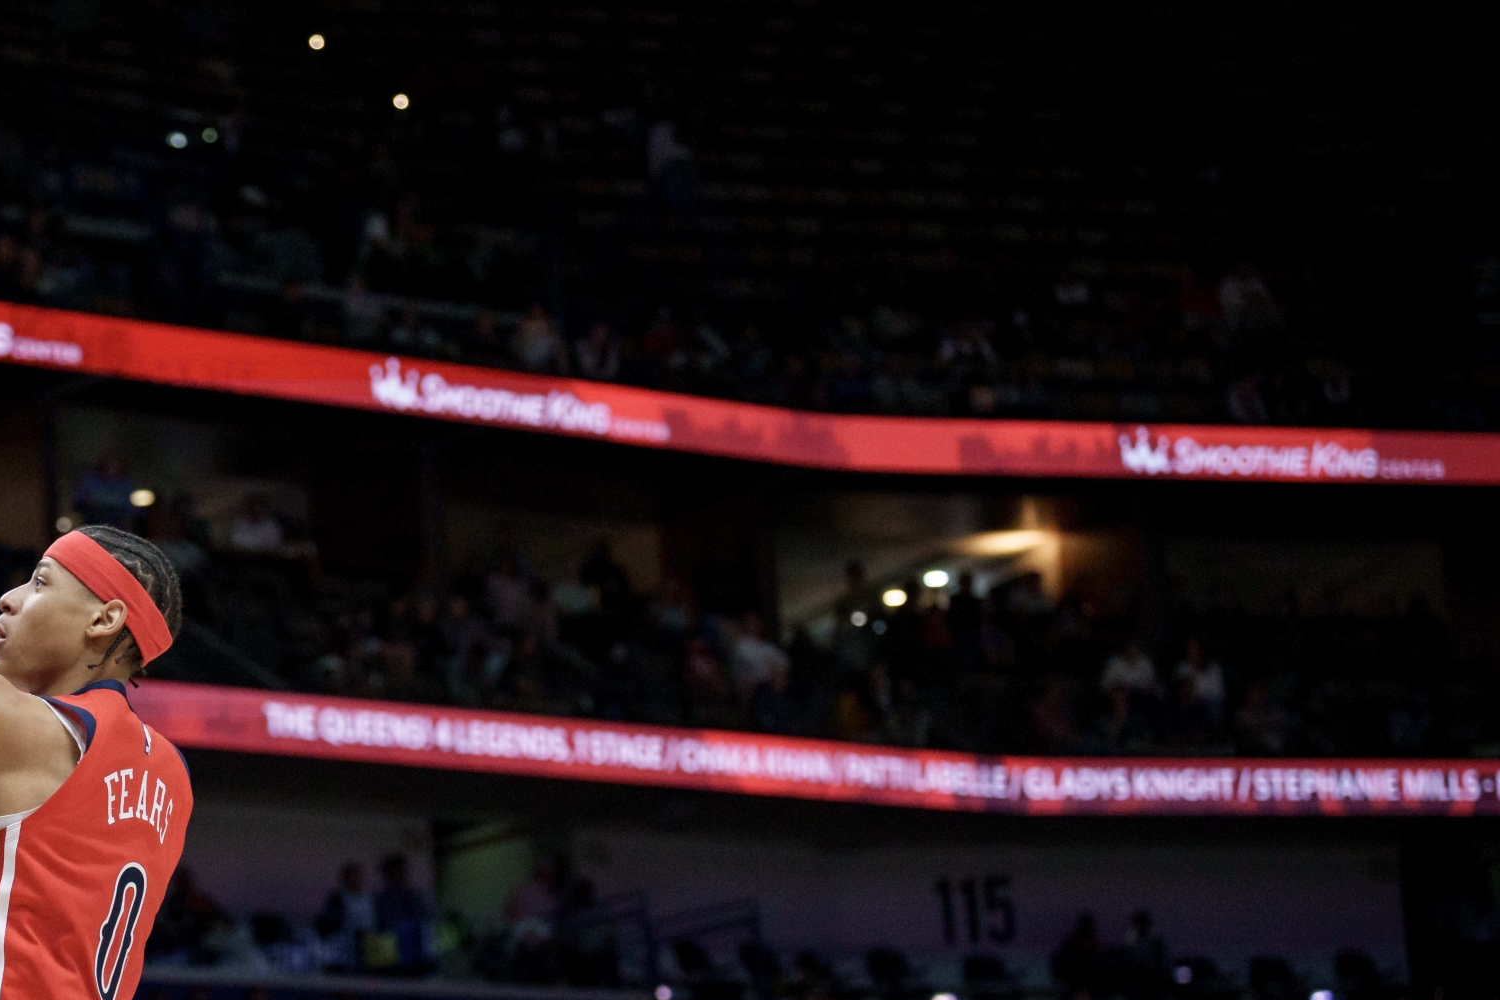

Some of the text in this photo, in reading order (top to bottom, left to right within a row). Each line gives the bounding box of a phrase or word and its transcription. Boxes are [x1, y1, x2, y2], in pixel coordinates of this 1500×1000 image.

[420, 373, 544, 427] SMOOTHIE
[545, 389, 611, 435] KING
[1173, 437, 1308, 477] SMOOTHIE
[1310, 441, 1378, 479] KING
[263, 701, 316, 742] THE
[589, 730, 665, 769] STAGE
[910, 759, 1006, 800] LABELLE
[1023, 767, 1130, 801] GLADYS
[1132, 766, 1236, 801] KNIGHT
[1253, 767, 1399, 802] STEPHANIE
[1402, 768, 1481, 802] MILLS
[104, 768, 173, 844] FEARS
[934, 876, 1014, 943] 115
